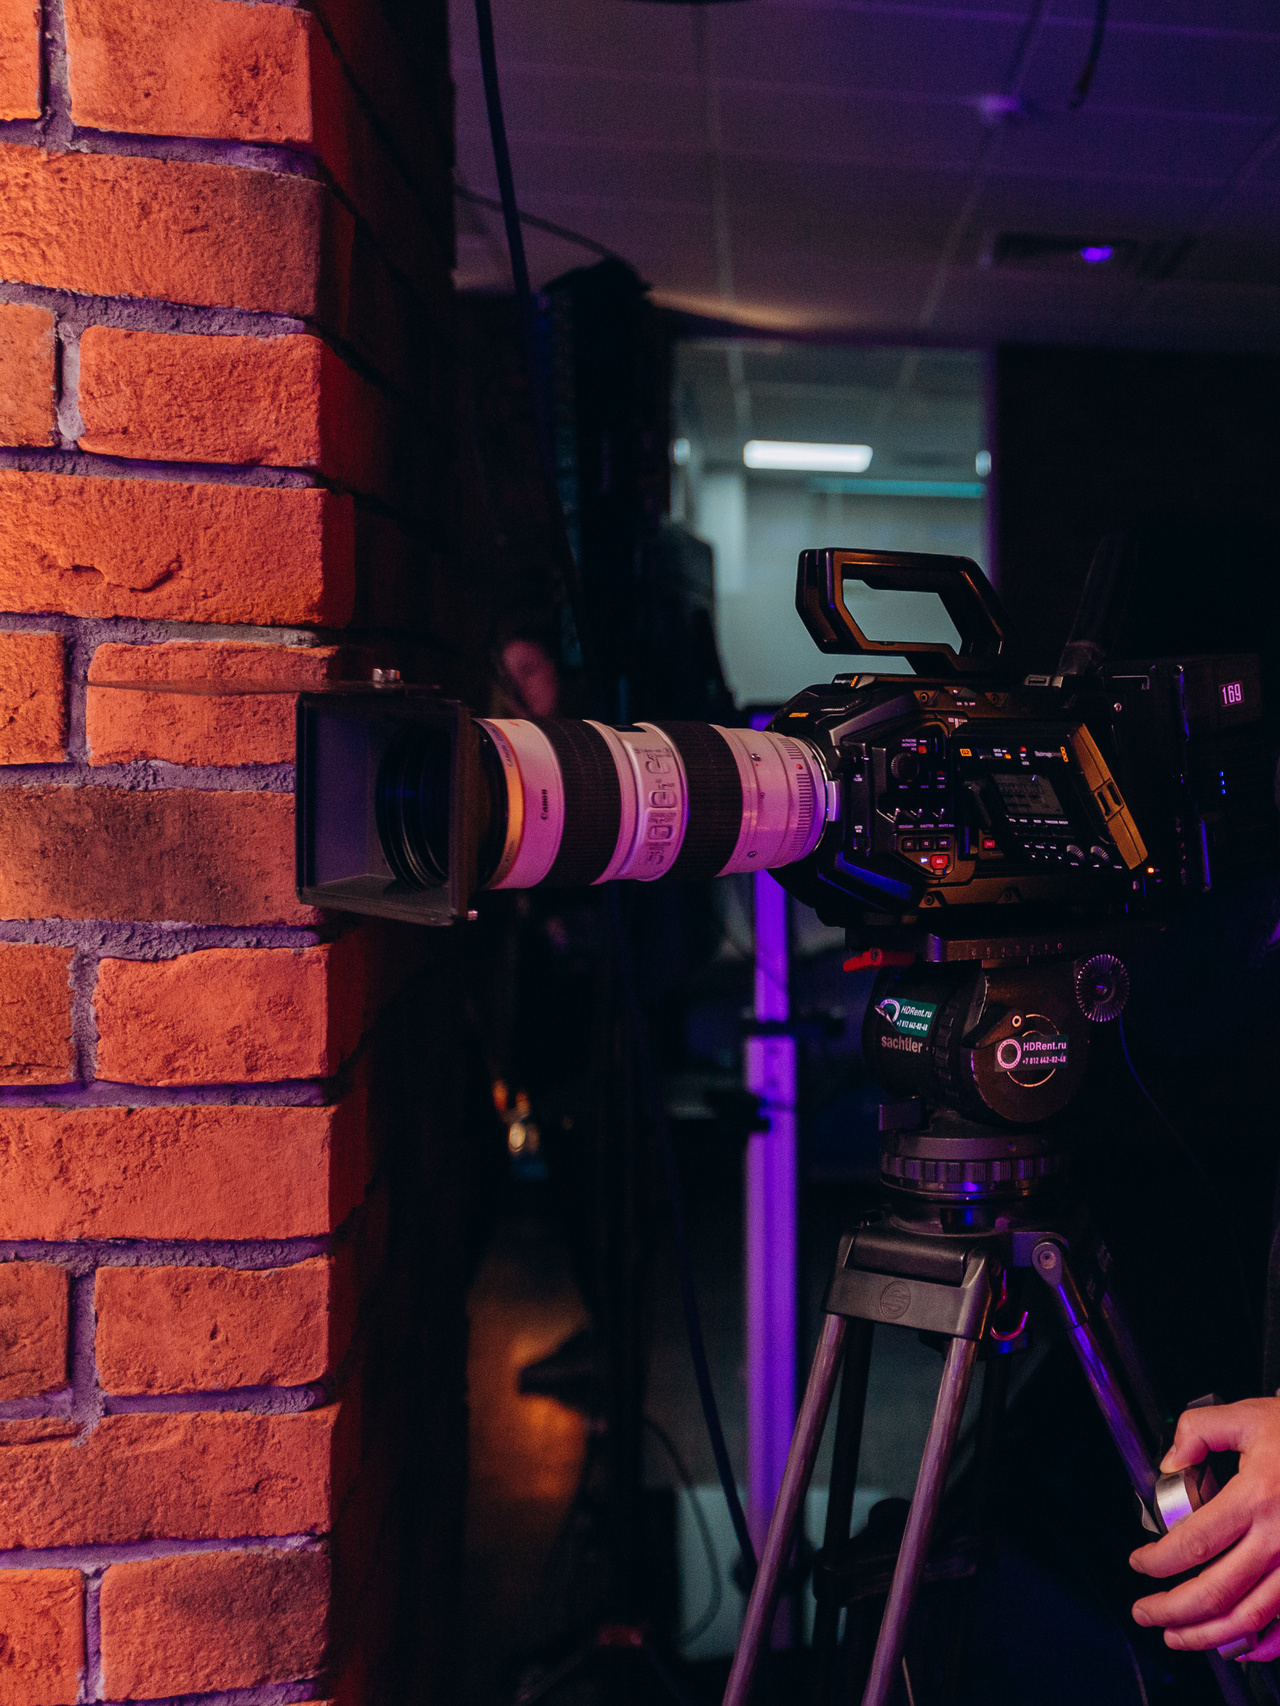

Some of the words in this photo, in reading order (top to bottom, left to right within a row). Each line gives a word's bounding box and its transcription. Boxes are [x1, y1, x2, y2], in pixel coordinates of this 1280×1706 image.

[1221, 683, 1242, 705] 169
[540, 789, 548, 820] Canon
[901, 1006, 932, 1018] HDRent.ru
[881, 1035, 923, 1054] sachtler
[1023, 1041, 1067, 1051] HDRent.ru
[1022, 1057, 1028, 1065] +7
